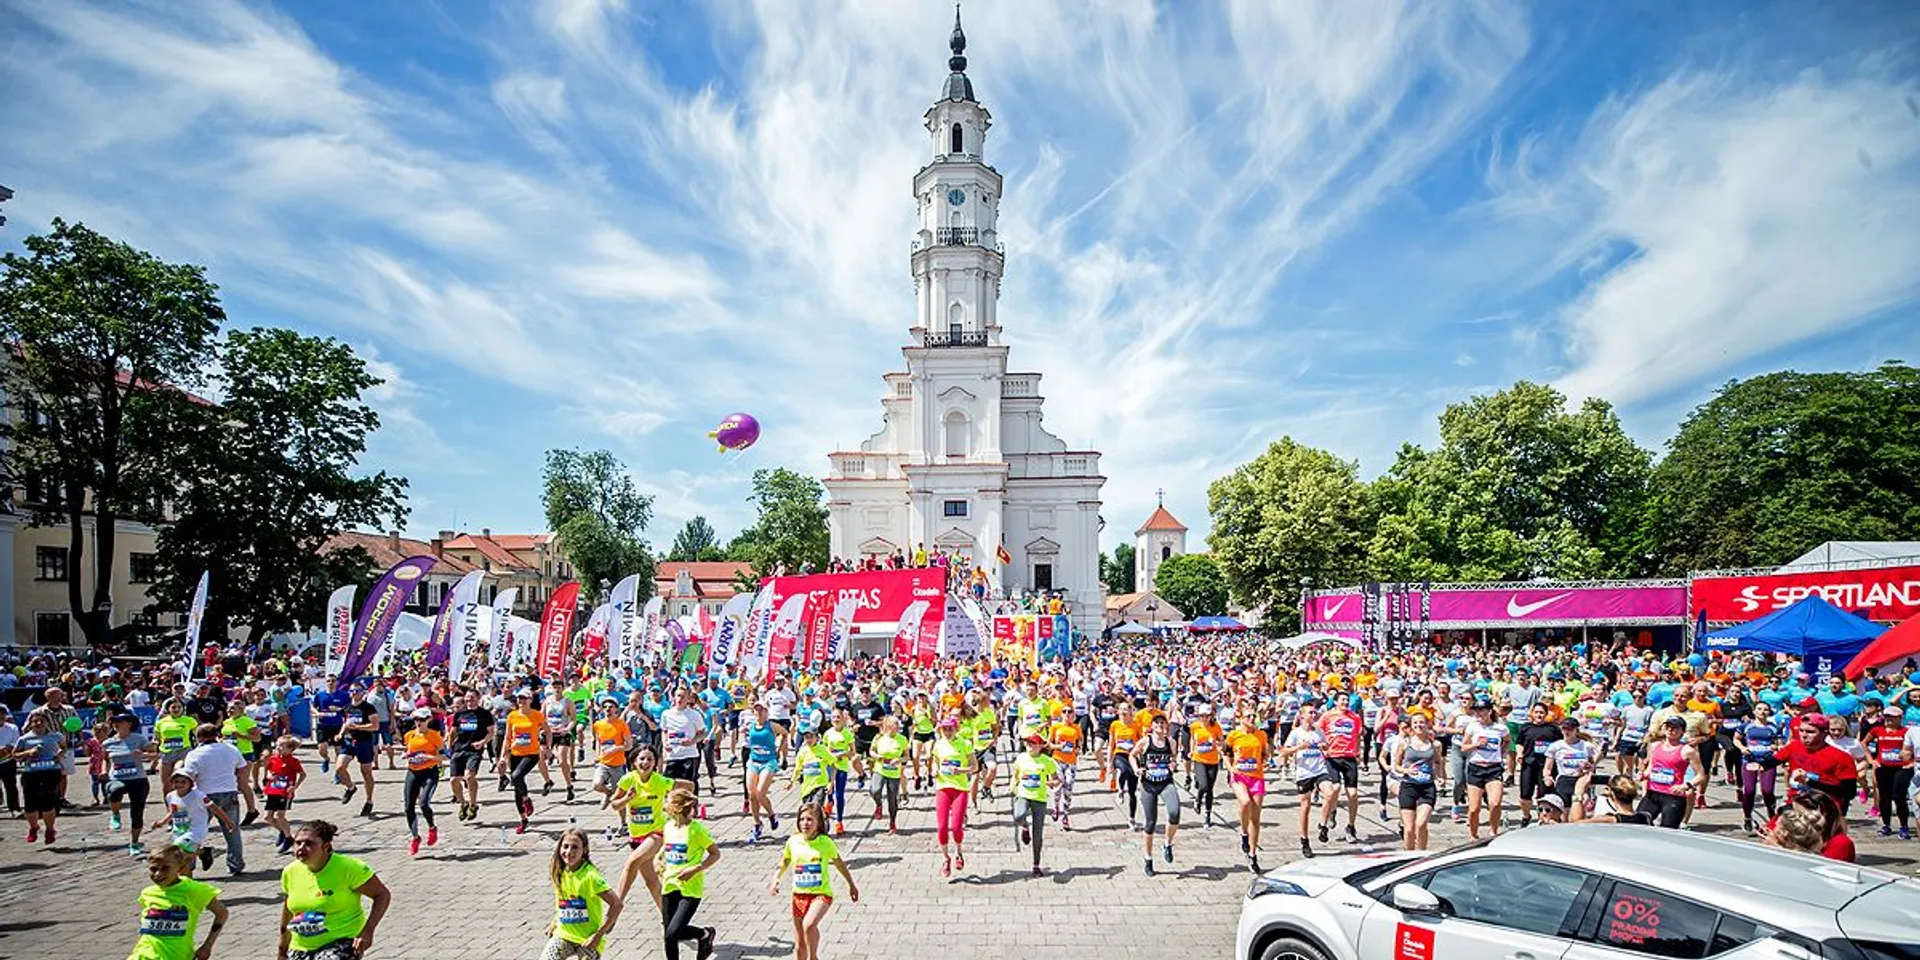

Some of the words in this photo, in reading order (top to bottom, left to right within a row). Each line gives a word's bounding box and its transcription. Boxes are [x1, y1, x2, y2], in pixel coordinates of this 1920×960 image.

[464, 603, 478, 656] RMIN
[494, 607, 511, 660] GARMIN
[621, 601, 635, 668] GARMIN
[712, 616, 736, 665] CORNY
[744, 608, 762, 656] TOYOTA
[1614, 900, 1661, 926] 0%
